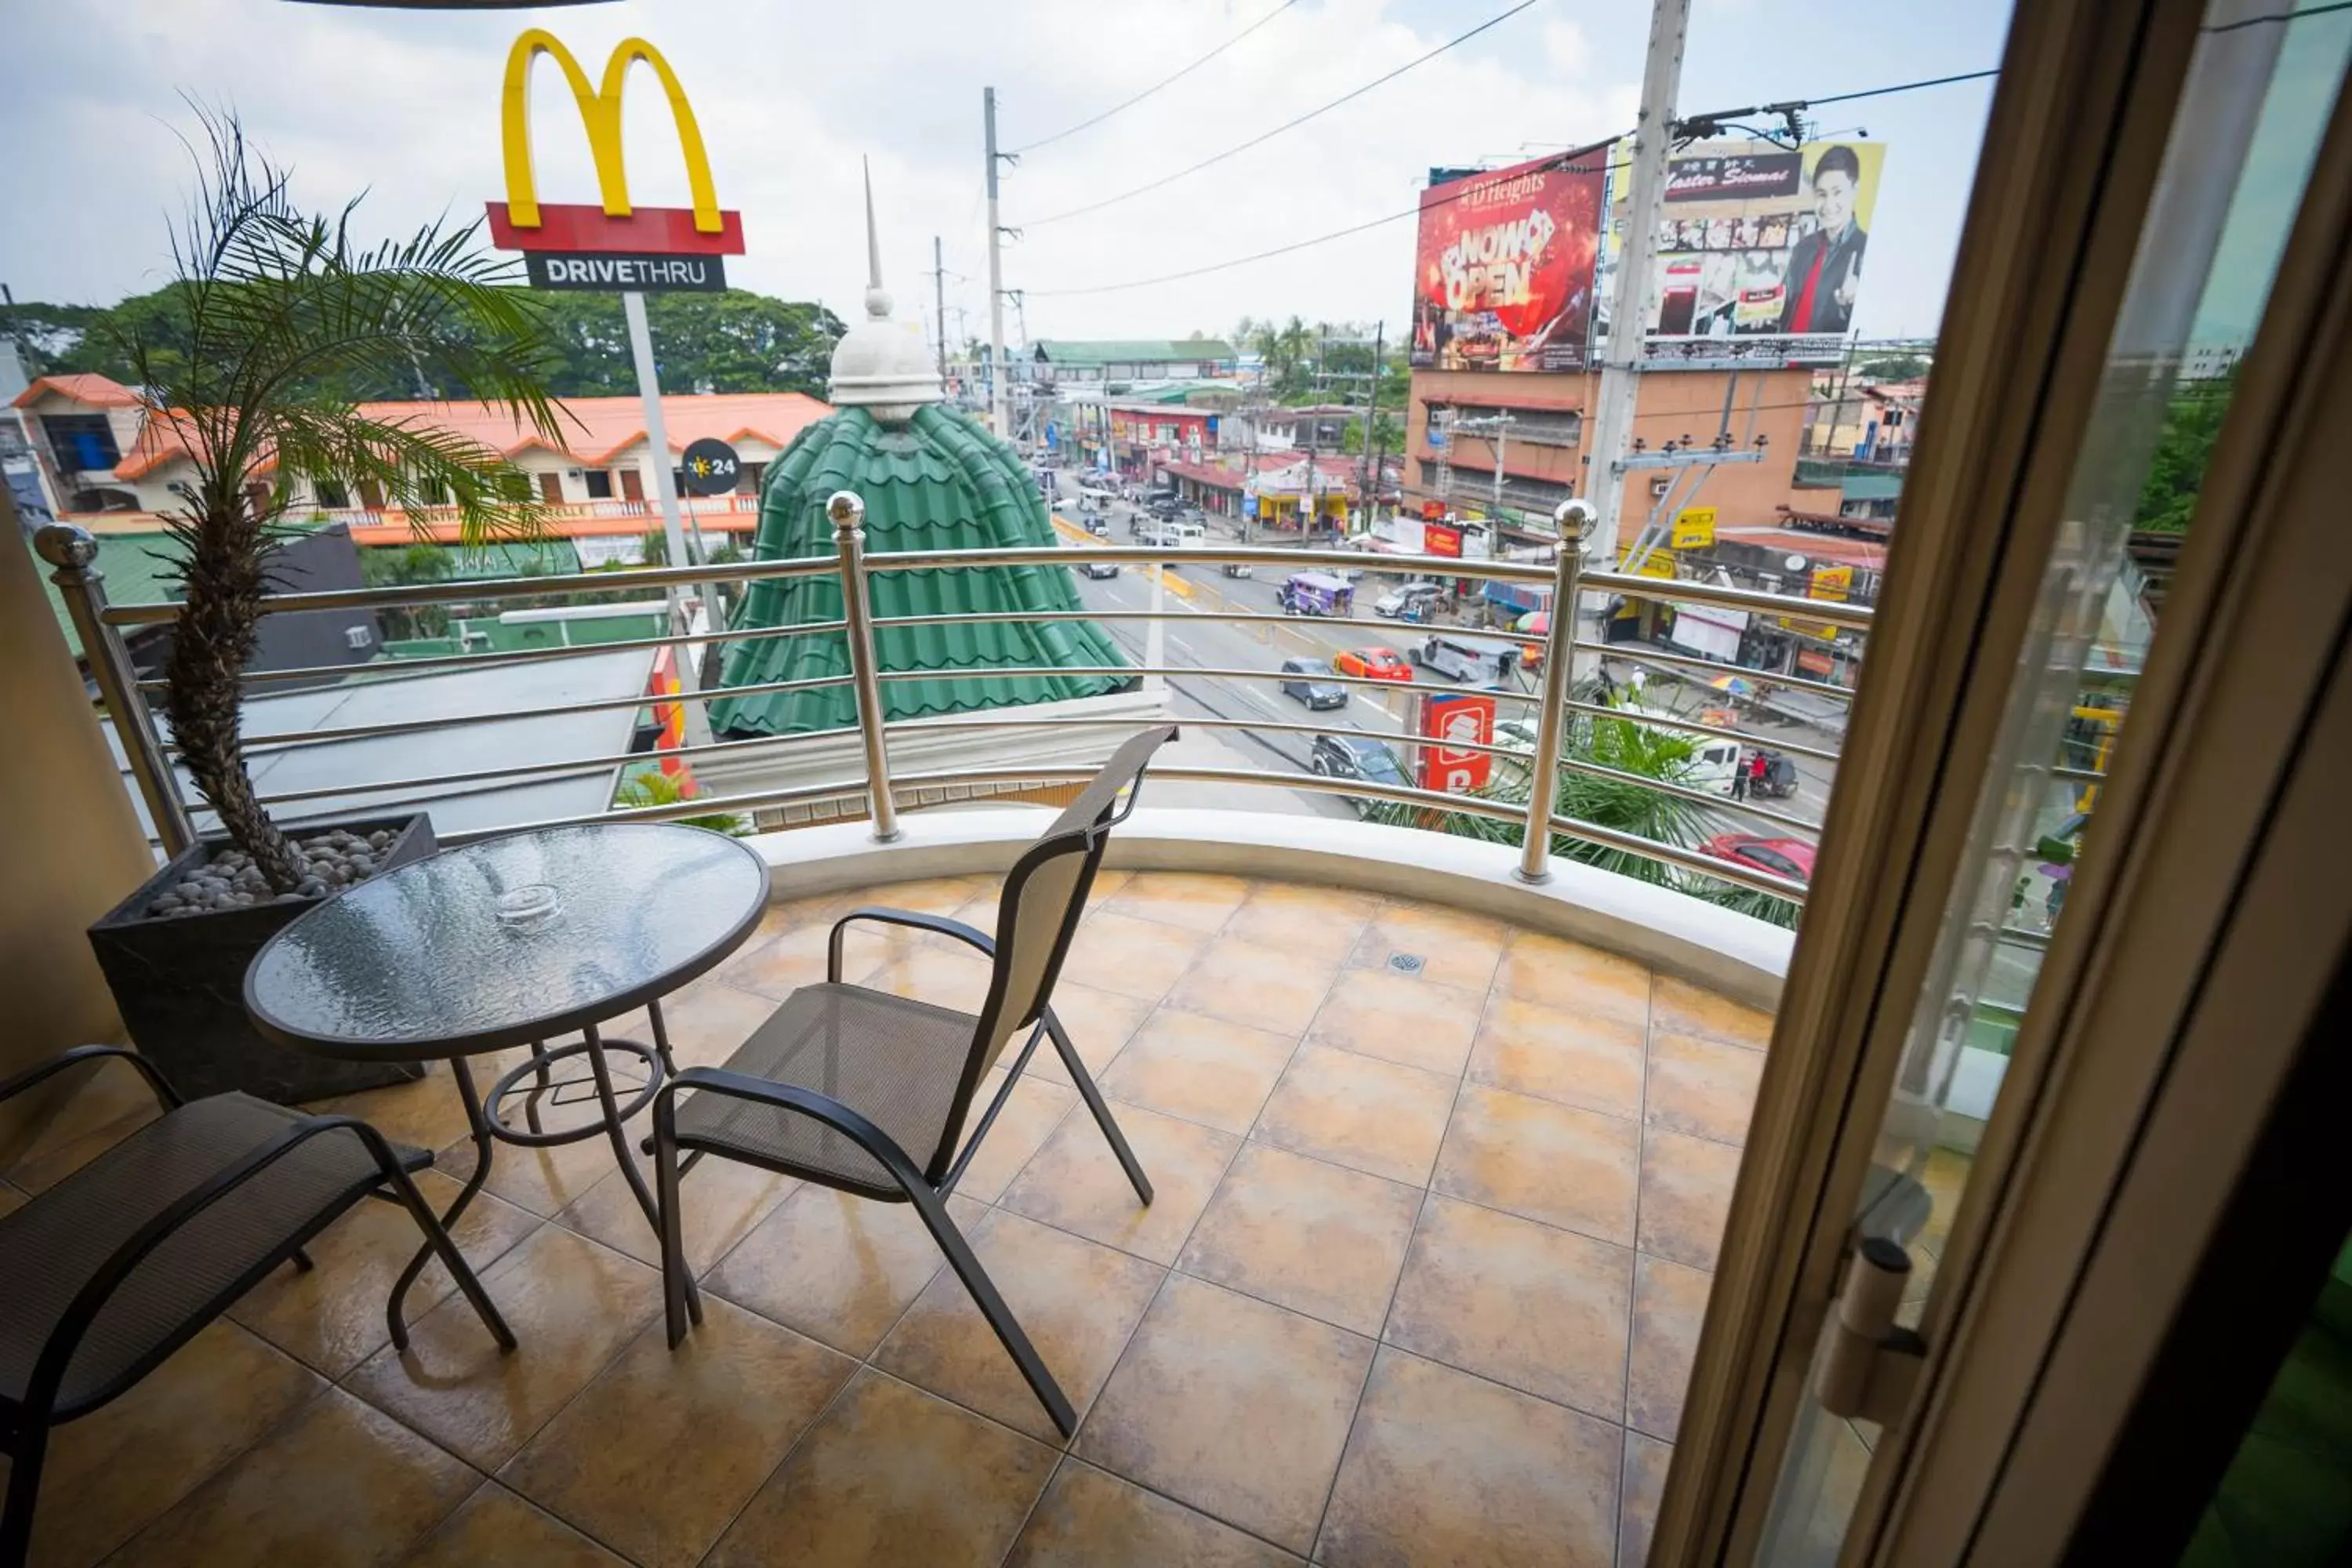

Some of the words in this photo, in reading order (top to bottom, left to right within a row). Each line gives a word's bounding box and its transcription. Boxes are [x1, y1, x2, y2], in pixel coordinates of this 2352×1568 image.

[1665, 170, 1716, 189] aster
[1721, 167, 1790, 186] Siomai
[1461, 219, 1530, 265] NOW
[1446, 260, 1530, 310] OPEN
[712, 459, 735, 475] 24
